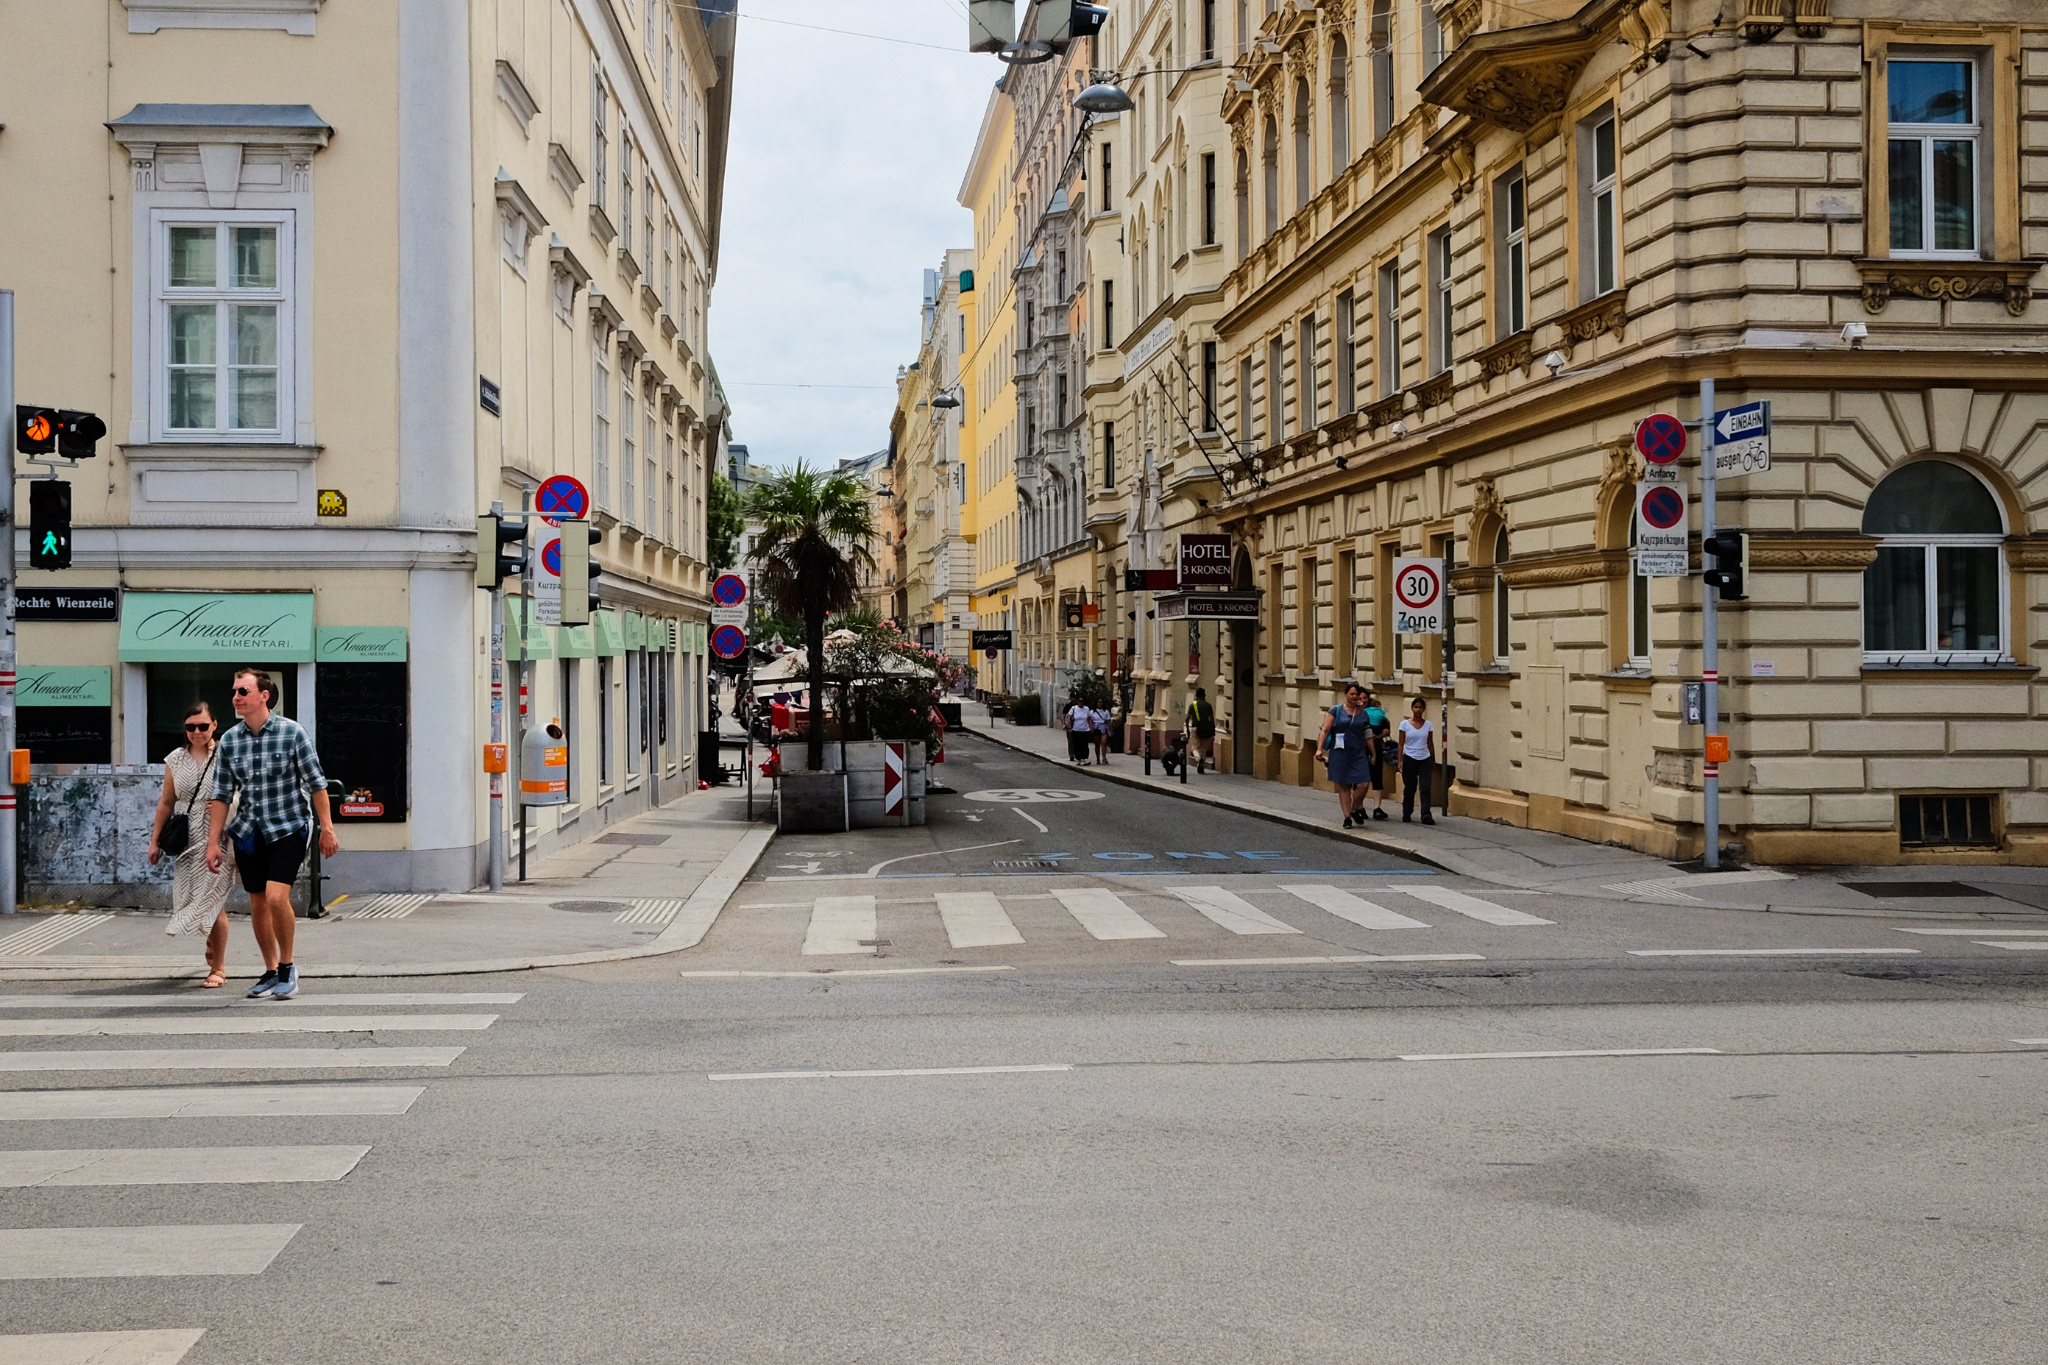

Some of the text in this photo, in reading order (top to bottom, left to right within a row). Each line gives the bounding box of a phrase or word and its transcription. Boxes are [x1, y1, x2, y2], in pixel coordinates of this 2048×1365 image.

[1731, 411, 1762, 431] EINBAHN
[1716, 452, 1743, 470] ausgen.
[1648, 468, 1677, 480] Anfang
[1640, 533, 1685, 547] Kurzparkzone
[1182, 544, 1230, 559] HOTEL
[1182, 565, 1231, 575] 3 KRONEN
[538, 581, 561, 590] Kurzpa
[1407, 576, 1429, 597] 30
[56, 596, 114, 609] Wienzeile
[1189, 603, 1215, 612] HOTEL
[1217, 603, 1222, 612] 3
[1224, 603, 1257, 612] KRONEN
[136, 600, 296, 641] Amacord
[323, 632, 399, 654] Amacord
[15, 672, 96, 696] Amacord
[986, 791, 1080, 801] 30
[1022, 851, 1299, 861] ZONE
